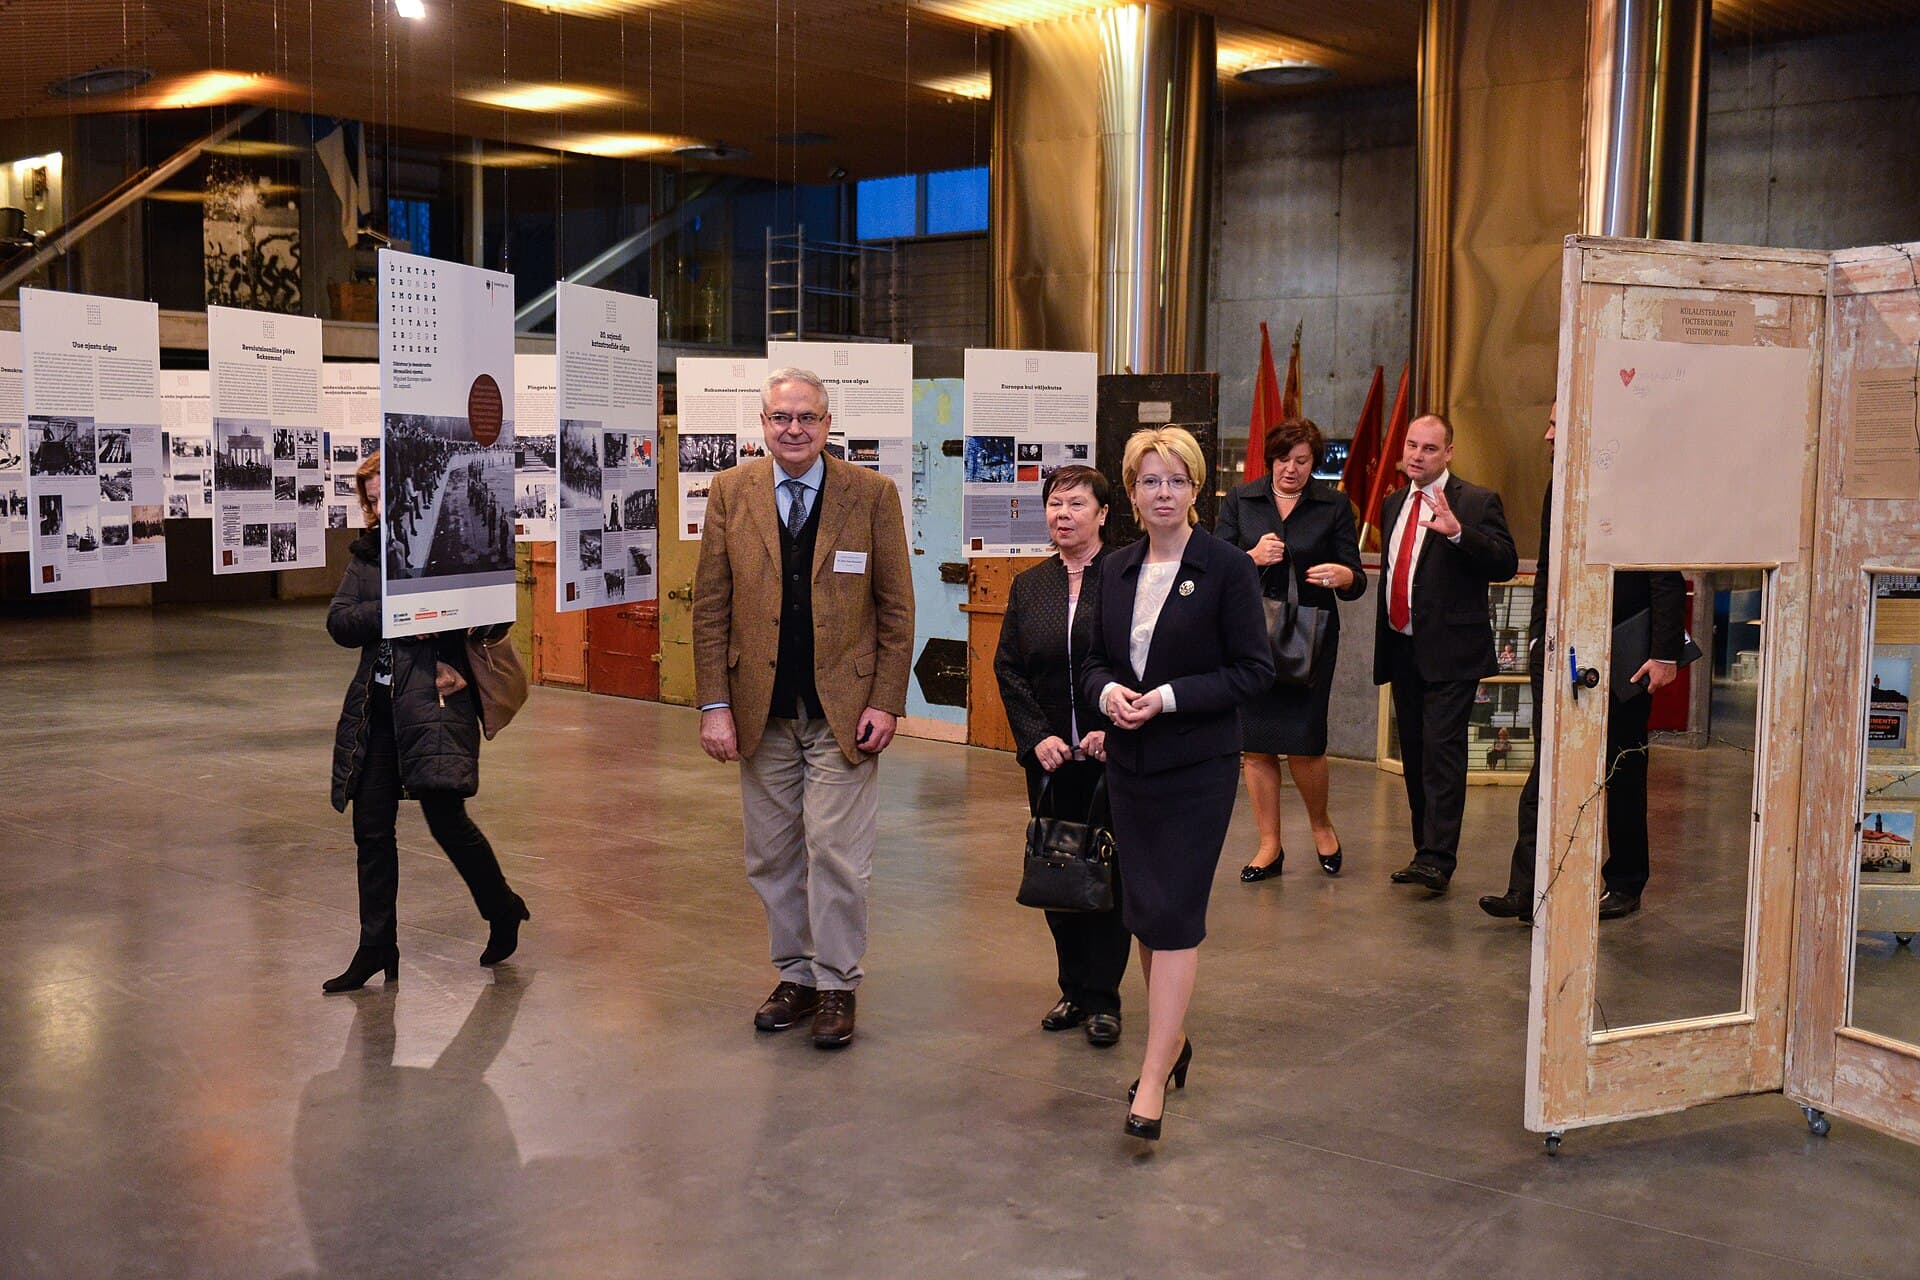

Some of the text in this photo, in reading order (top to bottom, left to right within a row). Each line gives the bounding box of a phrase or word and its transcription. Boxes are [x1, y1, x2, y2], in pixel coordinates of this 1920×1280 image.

[391, 264, 436, 277] DIKTAT
[391, 291, 437, 302] EMOKRA
[1714, 329, 1730, 337] PAGE
